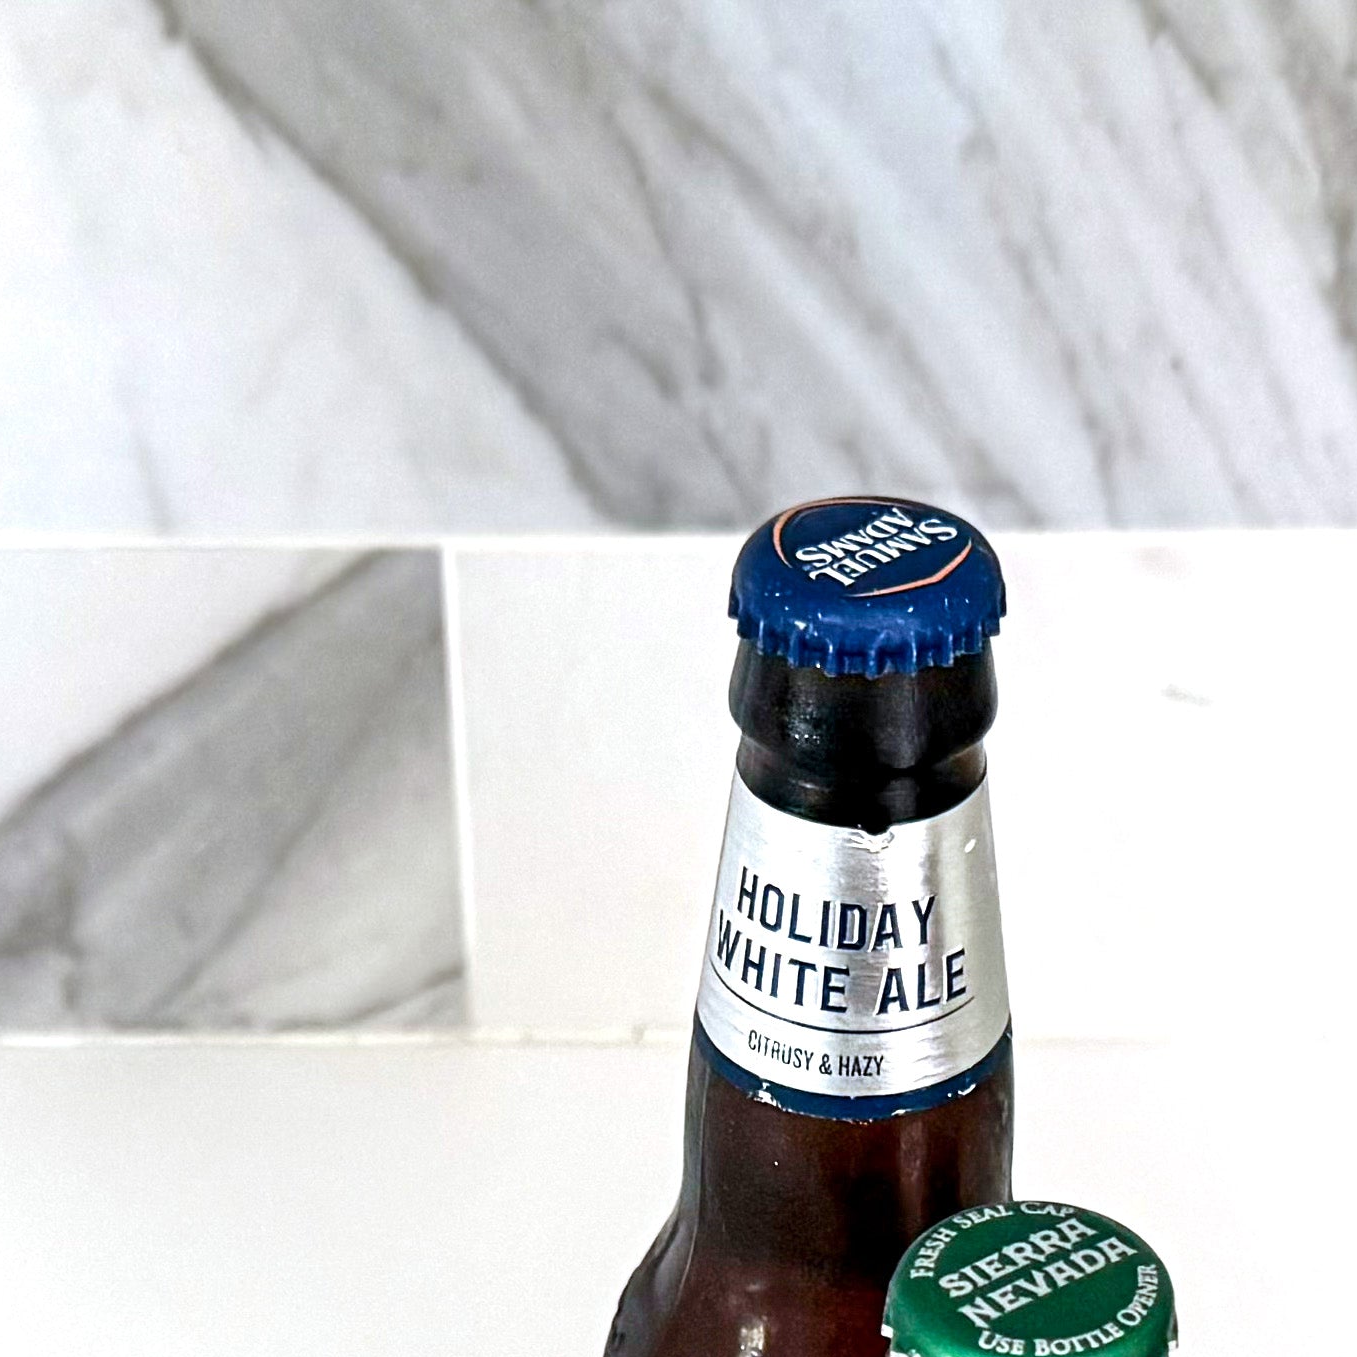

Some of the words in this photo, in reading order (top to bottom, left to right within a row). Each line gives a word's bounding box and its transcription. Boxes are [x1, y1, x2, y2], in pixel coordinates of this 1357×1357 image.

[796, 508, 915, 567] ADAMS
[810, 519, 958, 587] SAMUEL
[737, 866, 936, 952] HOLIDAY
[717, 910, 850, 1013] WHITE
[873, 948, 967, 1016] ALE
[748, 1030, 814, 1070] CITRUSY
[819, 1055, 832, 1075] &
[839, 1056, 884, 1077] HAZY
[910, 1229, 956, 1279] FRESH
[953, 1204, 1014, 1228] SEAL
[1020, 1201, 1074, 1218] CAP
[939, 1218, 1097, 1298] SIERRA
[957, 1237, 1139, 1328] NEVADA
[978, 1331, 1024, 1356] USE
[1035, 1322, 1124, 1356] BOTTLE
[1117, 1264, 1157, 1326] OPENER
